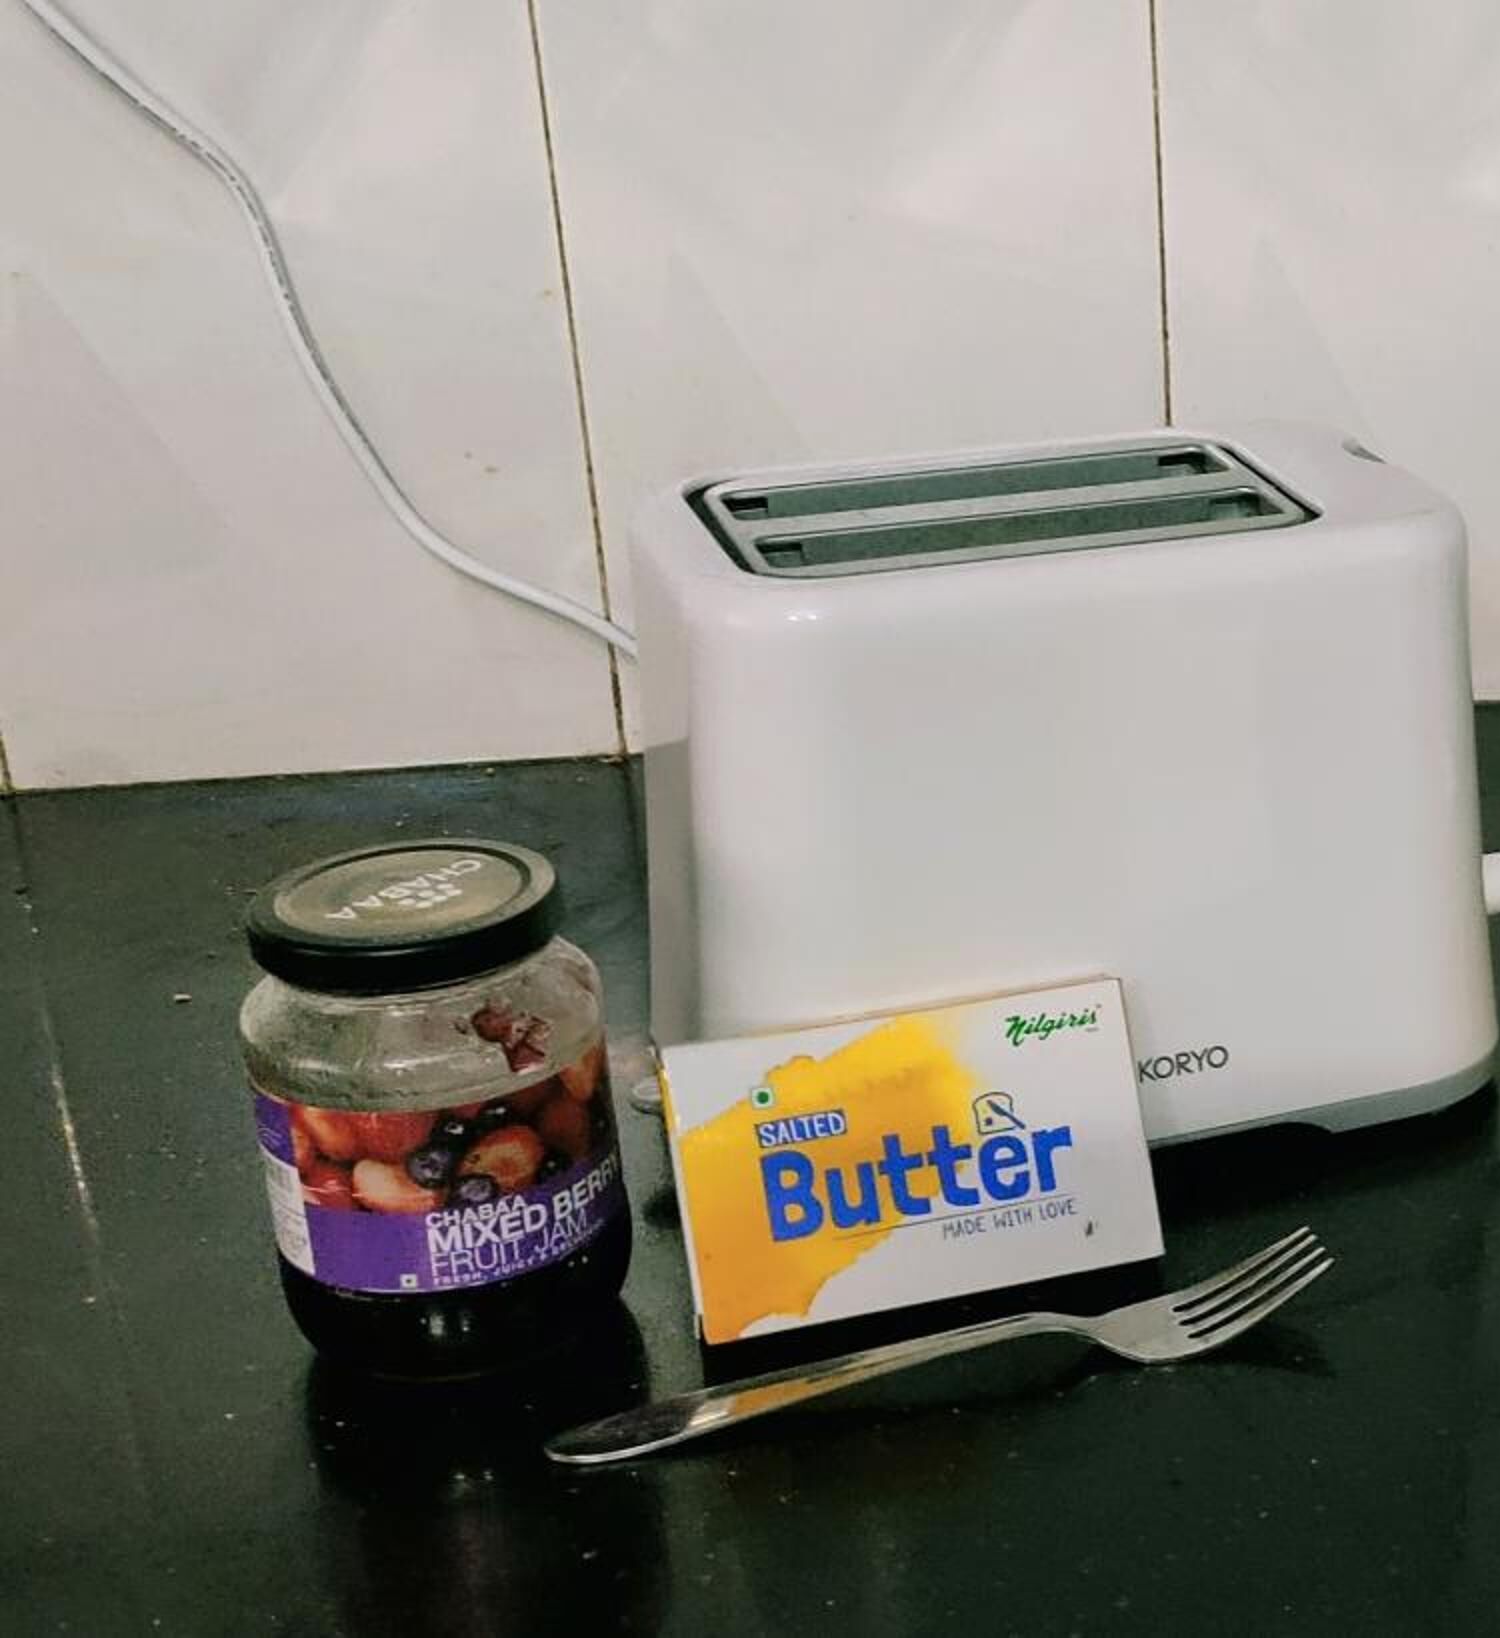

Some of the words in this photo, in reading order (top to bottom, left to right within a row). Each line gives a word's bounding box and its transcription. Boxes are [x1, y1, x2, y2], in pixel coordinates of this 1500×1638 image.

[323, 858, 482, 920] CHABAA
[1004, 1008, 1098, 1047] Nilgiris
[1137, 1045, 1230, 1084] KORYO
[757, 1111, 846, 1147] SALTED
[760, 1125, 1073, 1242] Butter
[424, 1194, 528, 1229] CHABAA
[427, 1203, 548, 1255] MIXED
[942, 1215, 987, 1240] MADE
[992, 1206, 1033, 1229] WITH
[1038, 1198, 1079, 1221] LOVE
[430, 1239, 521, 1277] FRUIT
[540, 1206, 589, 1252] JAM
